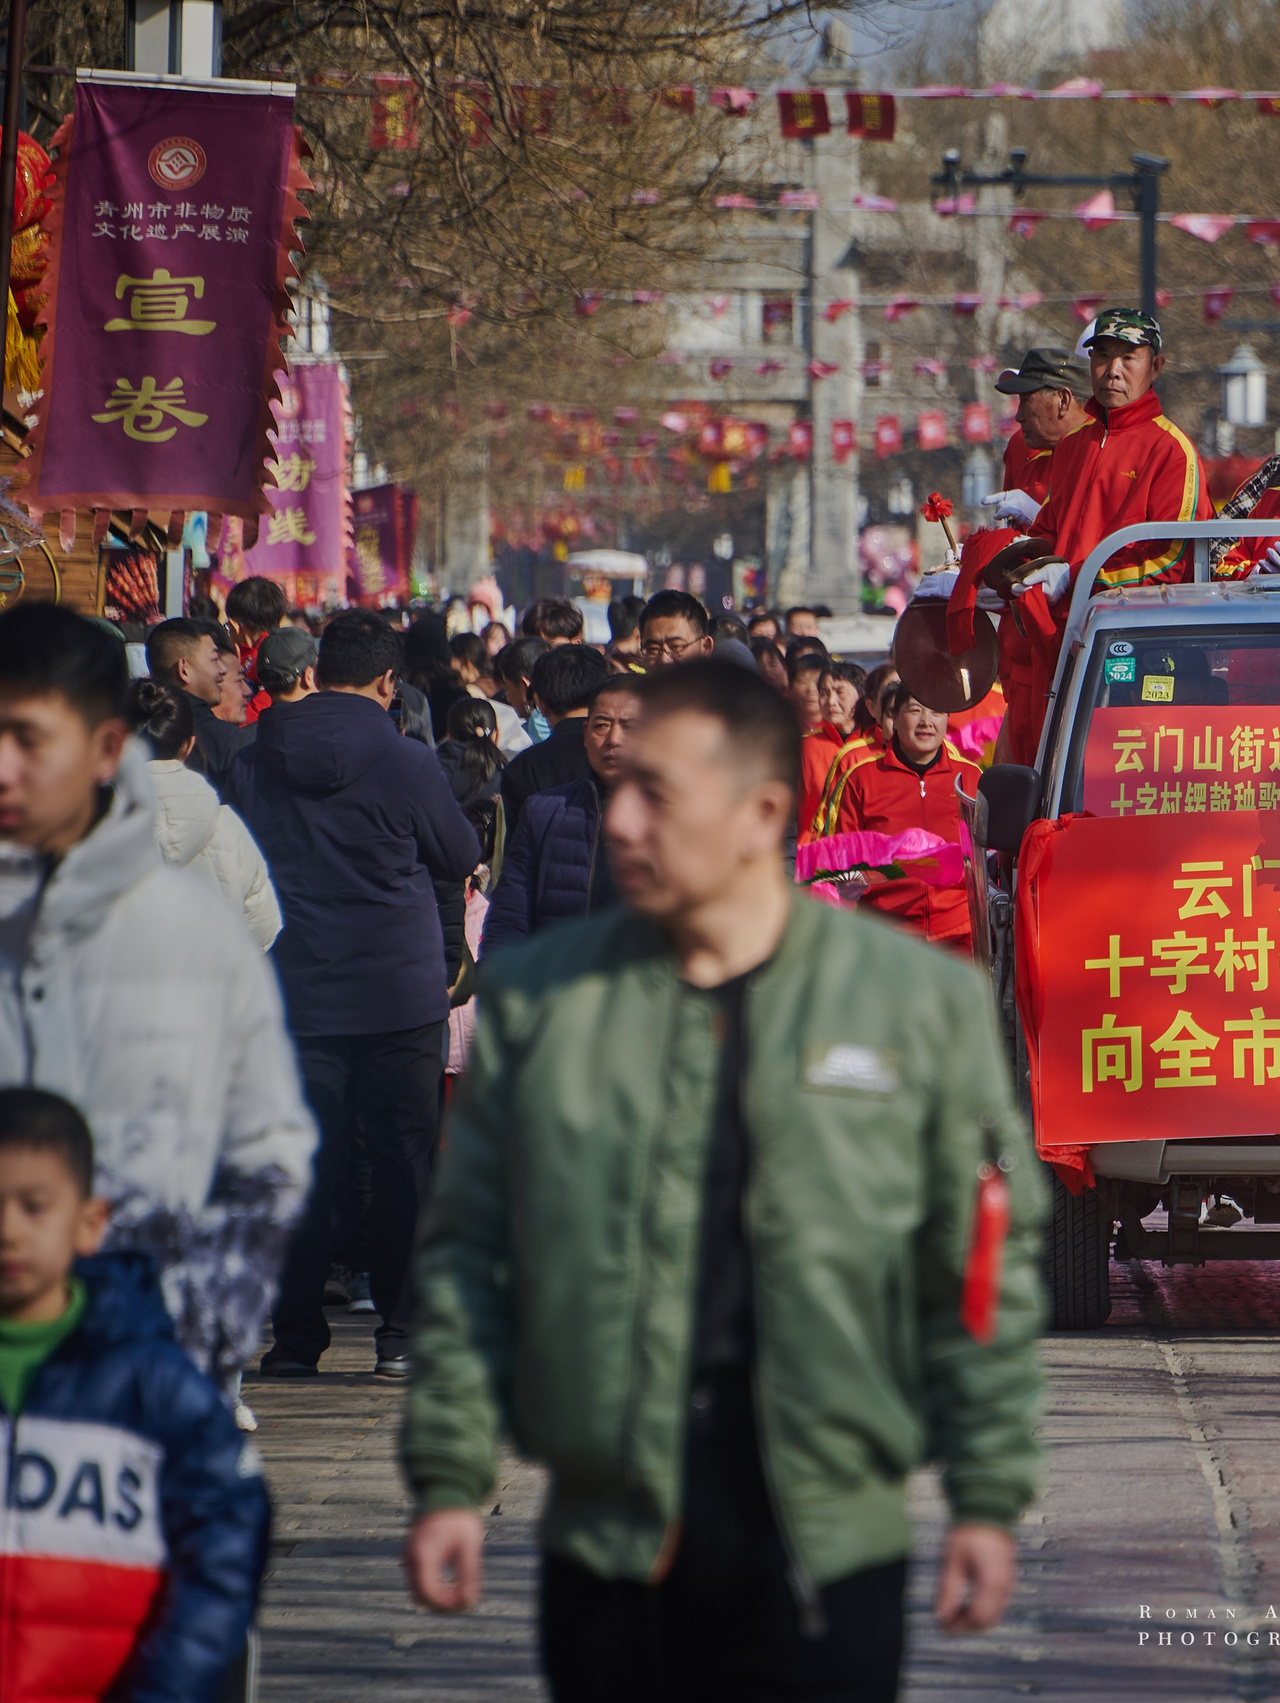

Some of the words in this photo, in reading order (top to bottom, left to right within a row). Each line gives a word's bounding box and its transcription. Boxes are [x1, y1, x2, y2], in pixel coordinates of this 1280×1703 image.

[94, 200, 252, 223] 青州市非物质
[91, 222, 249, 245] 文化遗产展演
[91, 268, 217, 443] 宣卷
[1145, 690, 1170, 700] 2023
